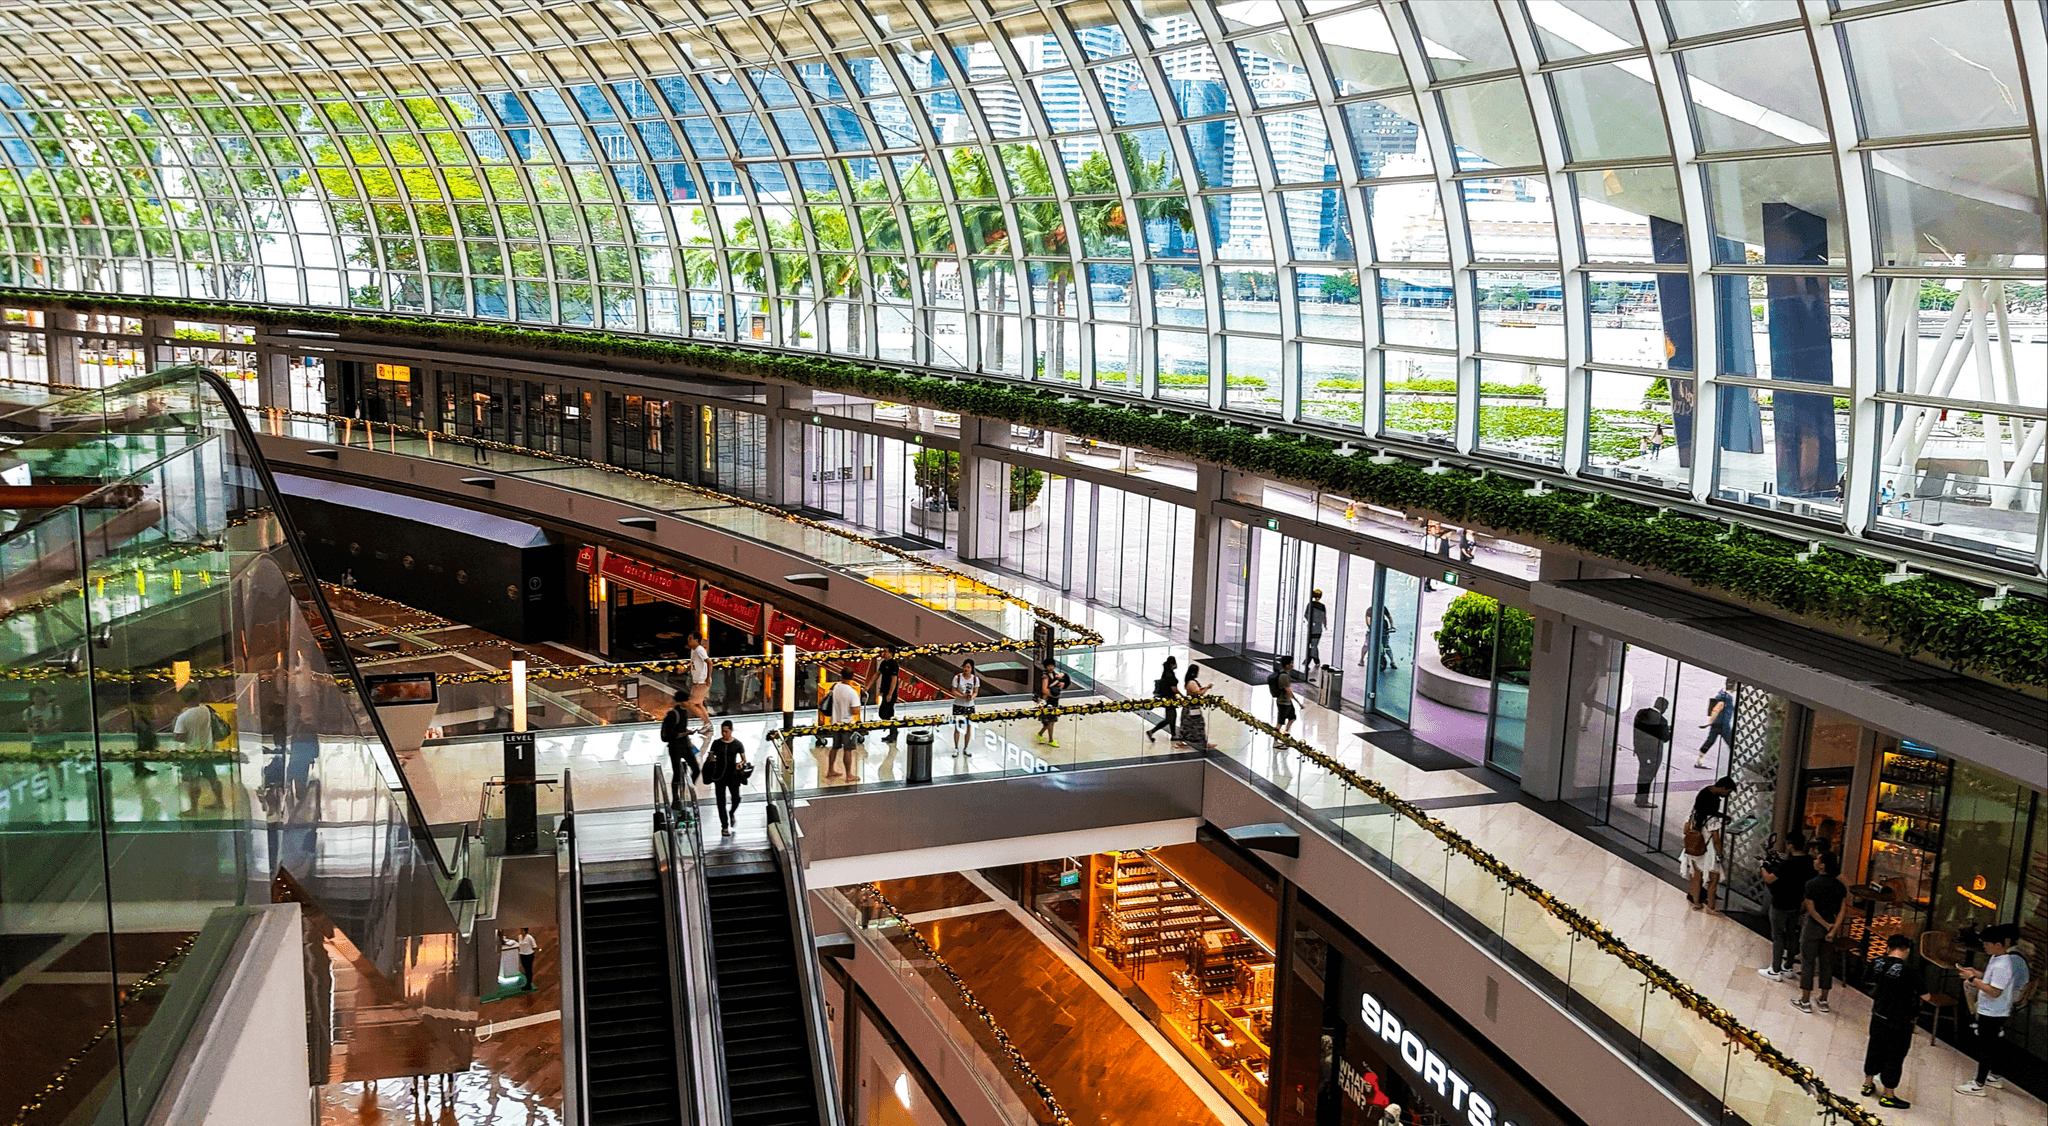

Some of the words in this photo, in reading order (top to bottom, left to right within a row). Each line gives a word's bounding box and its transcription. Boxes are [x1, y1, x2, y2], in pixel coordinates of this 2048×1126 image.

[515, 745, 523, 760] 1
[1361, 993, 1493, 1126] SPORTS
[1338, 1070, 1366, 1111] RAIN?
